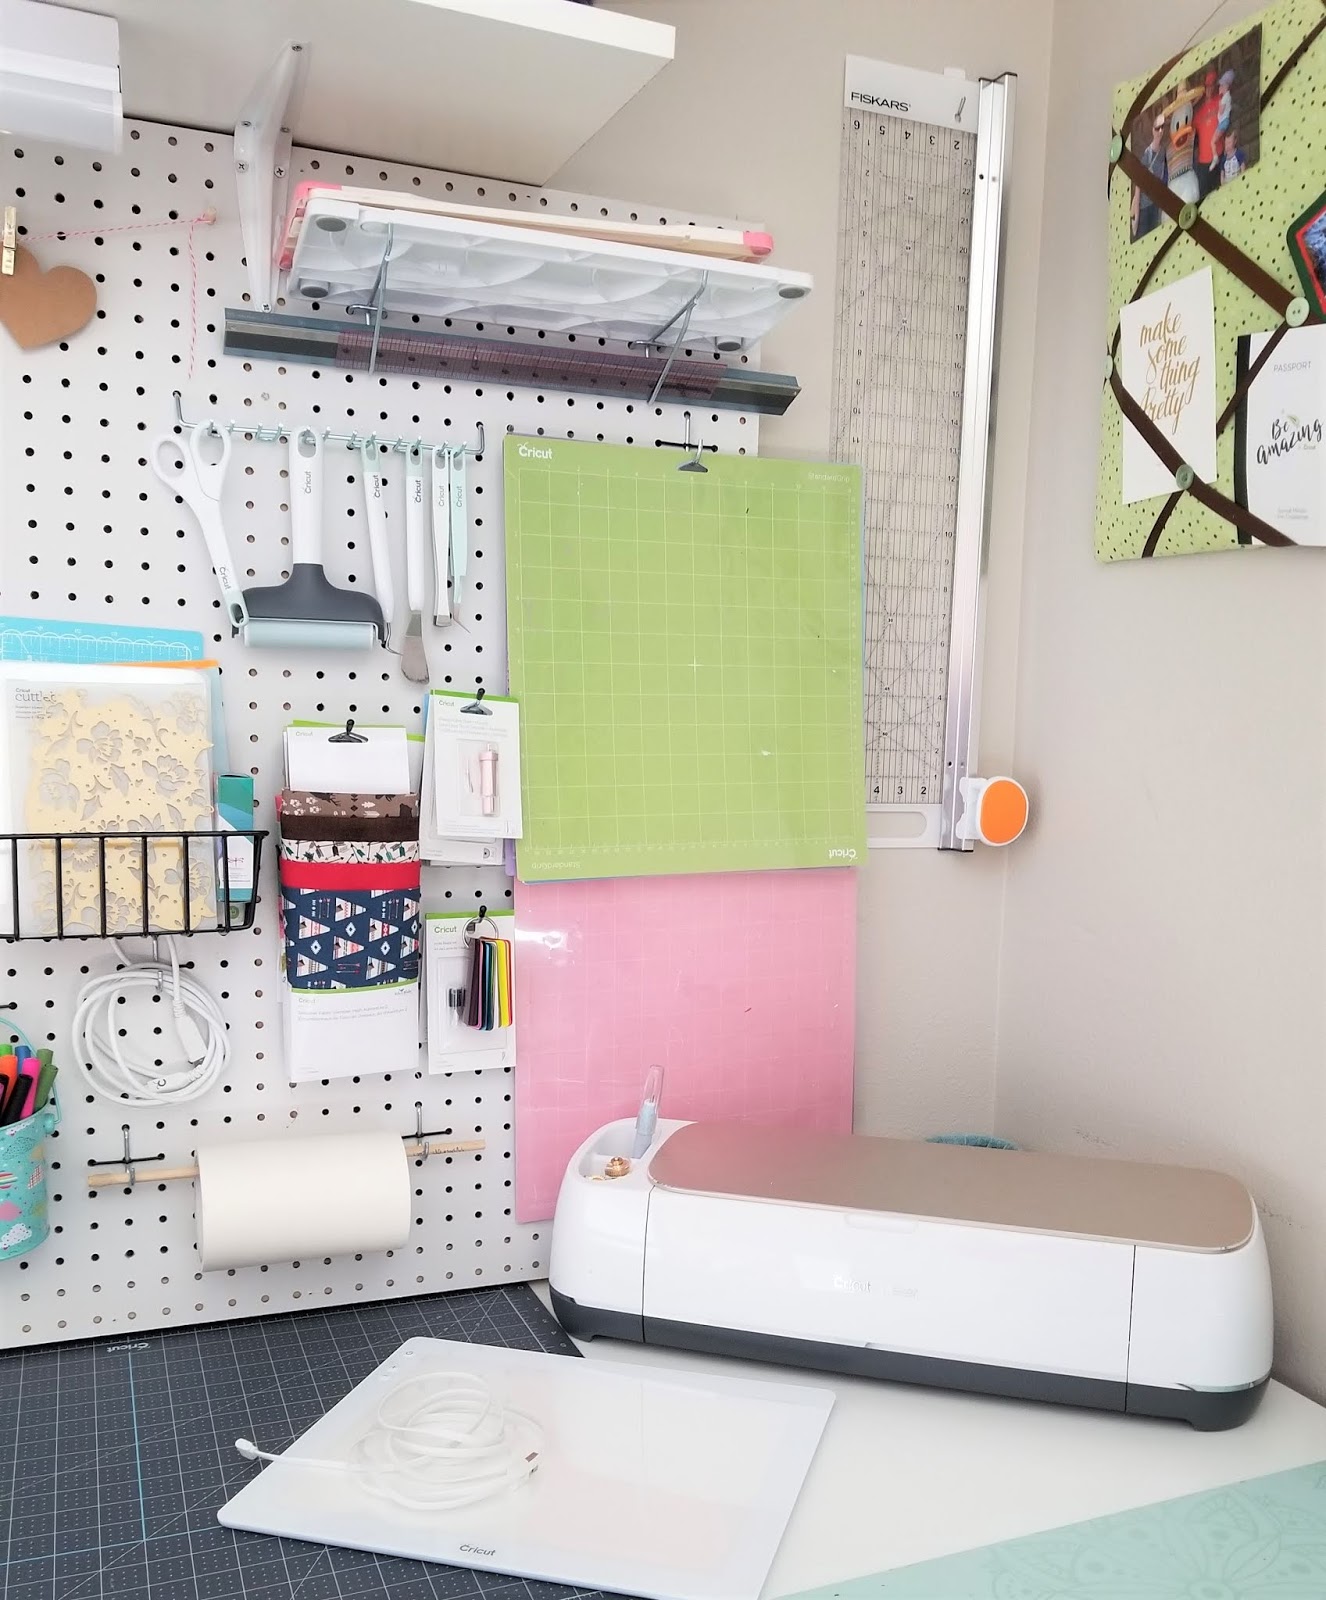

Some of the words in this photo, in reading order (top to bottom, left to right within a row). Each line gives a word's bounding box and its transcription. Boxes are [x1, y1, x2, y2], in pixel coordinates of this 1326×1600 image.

[850, 91, 909, 112] FISKARS
[879, 125, 886, 136] 5
[904, 130, 911, 140] 4
[929, 135, 936, 146] 3
[953, 140, 961, 150] 2
[1139, 302, 1181, 347] make
[1146, 336, 1187, 384] some
[1273, 361, 1311, 372] PASSPORT
[1160, 356, 1200, 405] thing
[1271, 418, 1290, 441] Be
[517, 441, 553, 460] Cricut
[303, 471, 311, 494] Cricut
[372, 474, 381, 498] Cricut
[414, 479, 422, 503] Cricut
[219, 566, 232, 590] Cricut
[873, 785, 880, 795] 4
[897, 785, 904, 795] 3
[920, 786, 927, 795] 2
[828, 848, 858, 863] Cricut
[433, 923, 457, 934] Cricut
[107, 1342, 150, 1353] Cricut
[458, 1544, 496, 1556] Cricut
